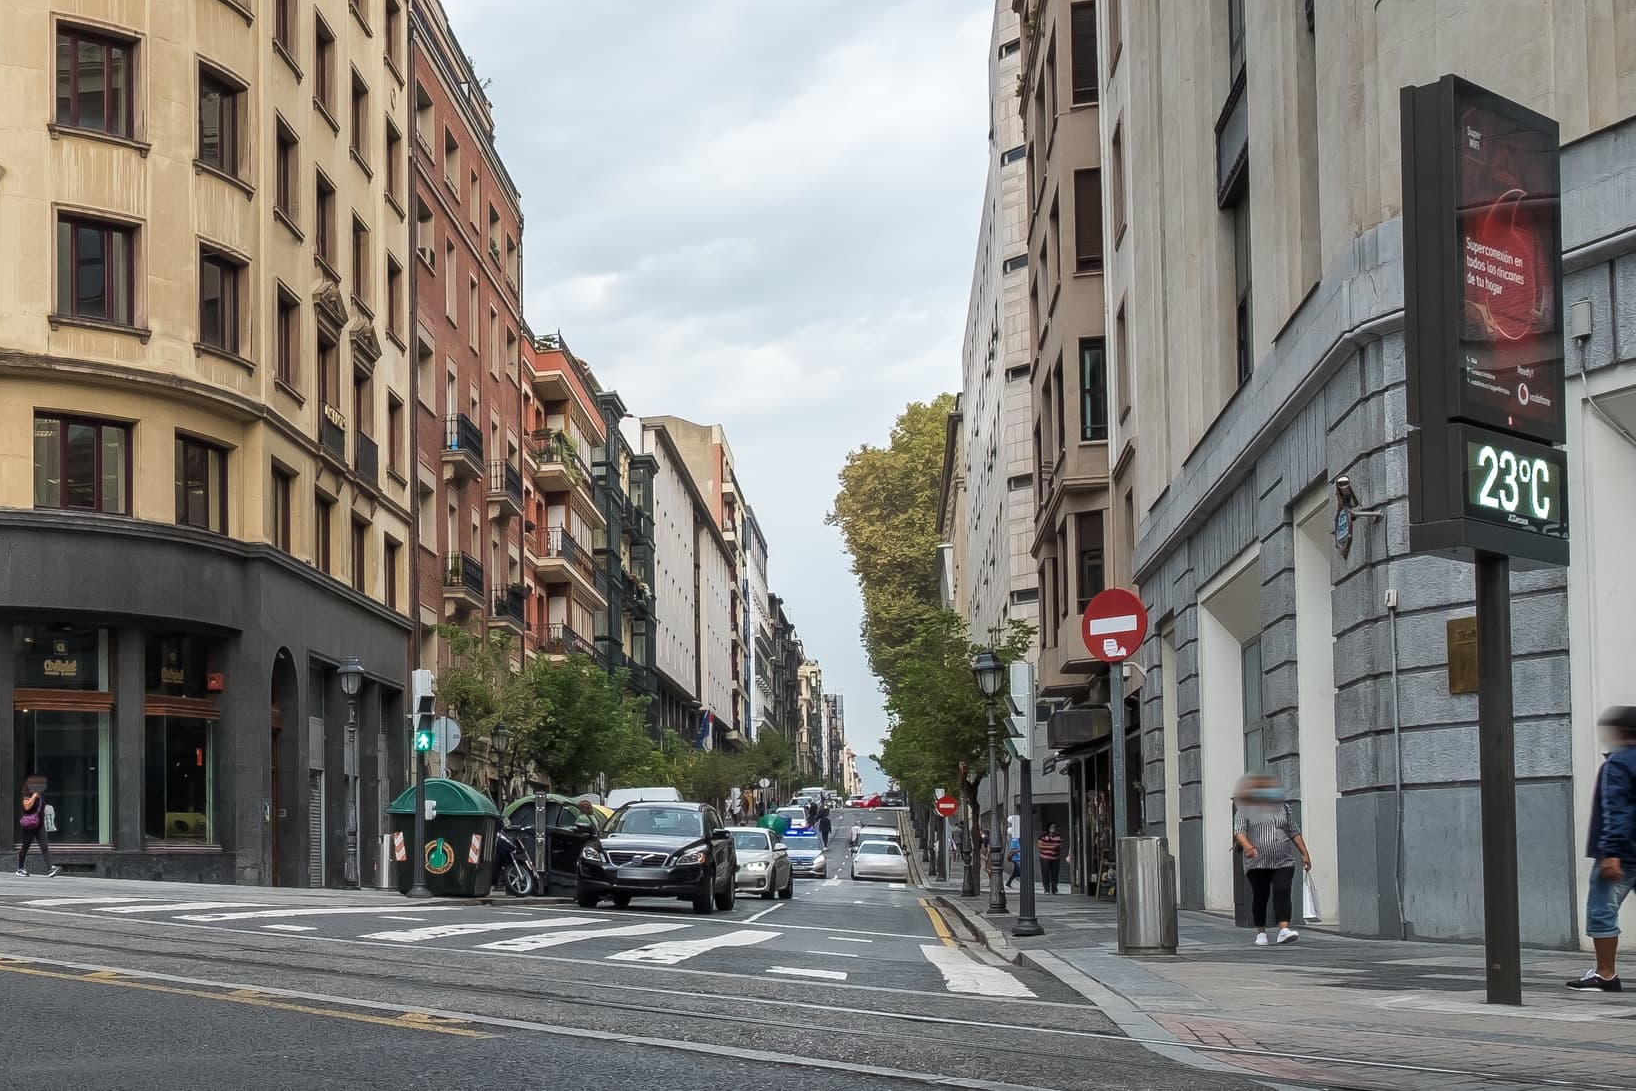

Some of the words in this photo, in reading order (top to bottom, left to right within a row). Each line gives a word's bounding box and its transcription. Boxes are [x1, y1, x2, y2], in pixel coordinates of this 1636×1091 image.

[1466, 254, 1486, 271] todos
[1486, 260, 1497, 275] los
[1496, 265, 1525, 285] rincones
[1466, 271, 1476, 285] de
[1476, 275, 1484, 287] tu
[1485, 277, 1503, 296] hogar
